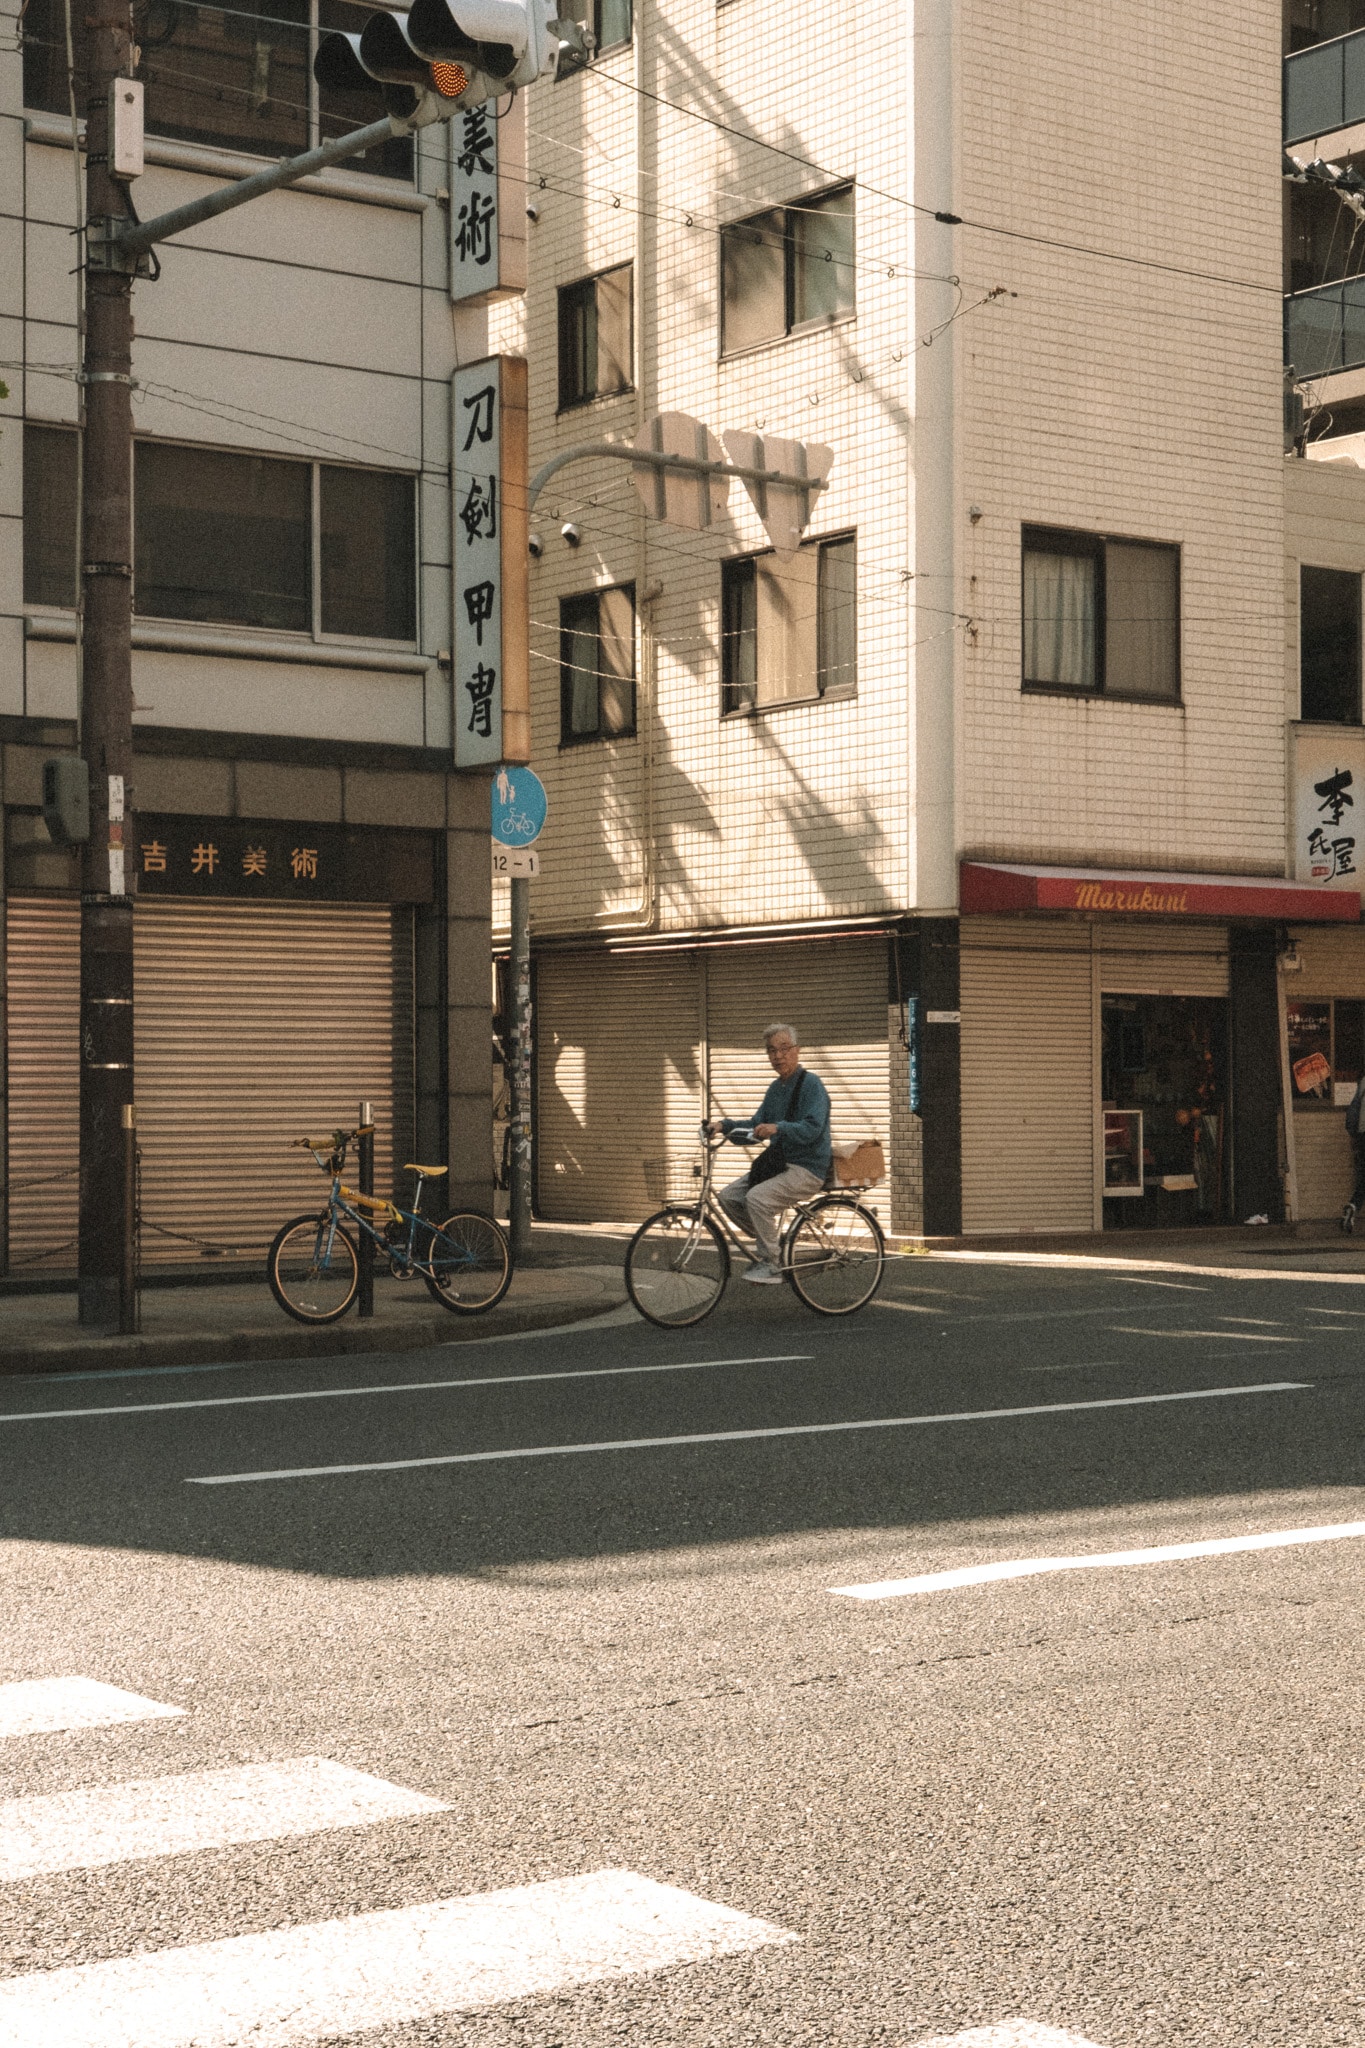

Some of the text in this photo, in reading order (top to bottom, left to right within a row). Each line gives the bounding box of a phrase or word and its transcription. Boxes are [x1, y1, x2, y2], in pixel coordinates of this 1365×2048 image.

[455, 104, 496, 266] 美術
[140, 840, 318, 879] 吉井美術
[1074, 882, 1188, 912] Marukuni
